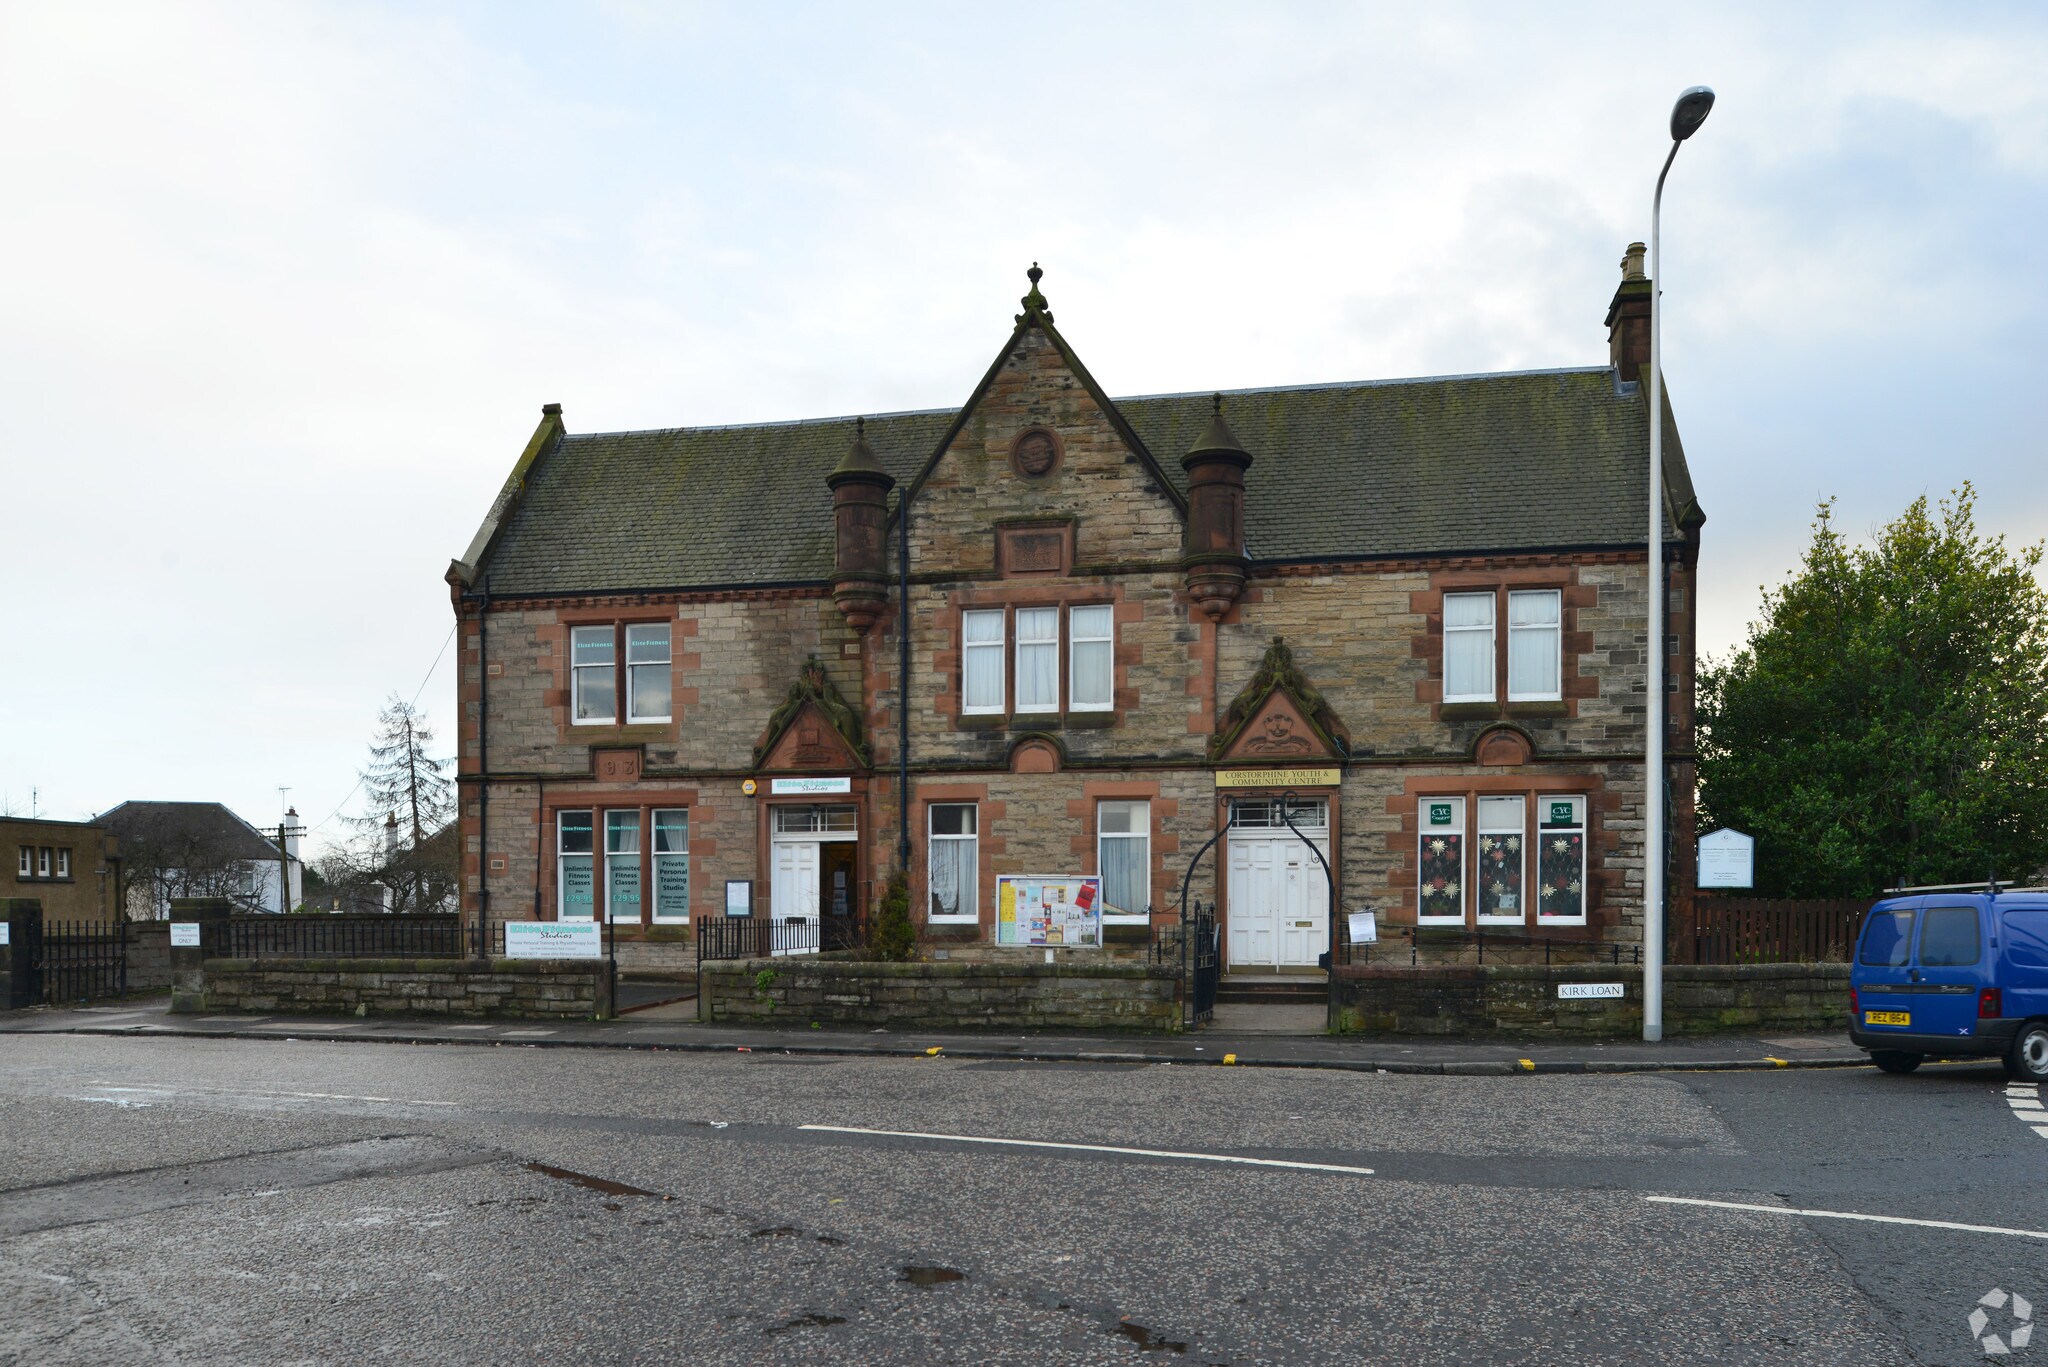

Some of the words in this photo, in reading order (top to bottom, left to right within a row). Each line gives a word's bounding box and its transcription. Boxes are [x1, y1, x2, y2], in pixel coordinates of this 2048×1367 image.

[801, 784, 828, 792] Studios
[1432, 807, 1450, 816] CYC
[1552, 806, 1571, 814] CYC
[510, 925, 541, 933] Elite
[542, 925, 593, 933] Fitness
[540, 930, 572, 939] Studios
[1561, 986, 1587, 996] KIRK
[1591, 985, 1621, 996] LOAN
[1872, 1012, 1887, 1023] REZ
[1888, 1013, 1907, 1023] 1864
